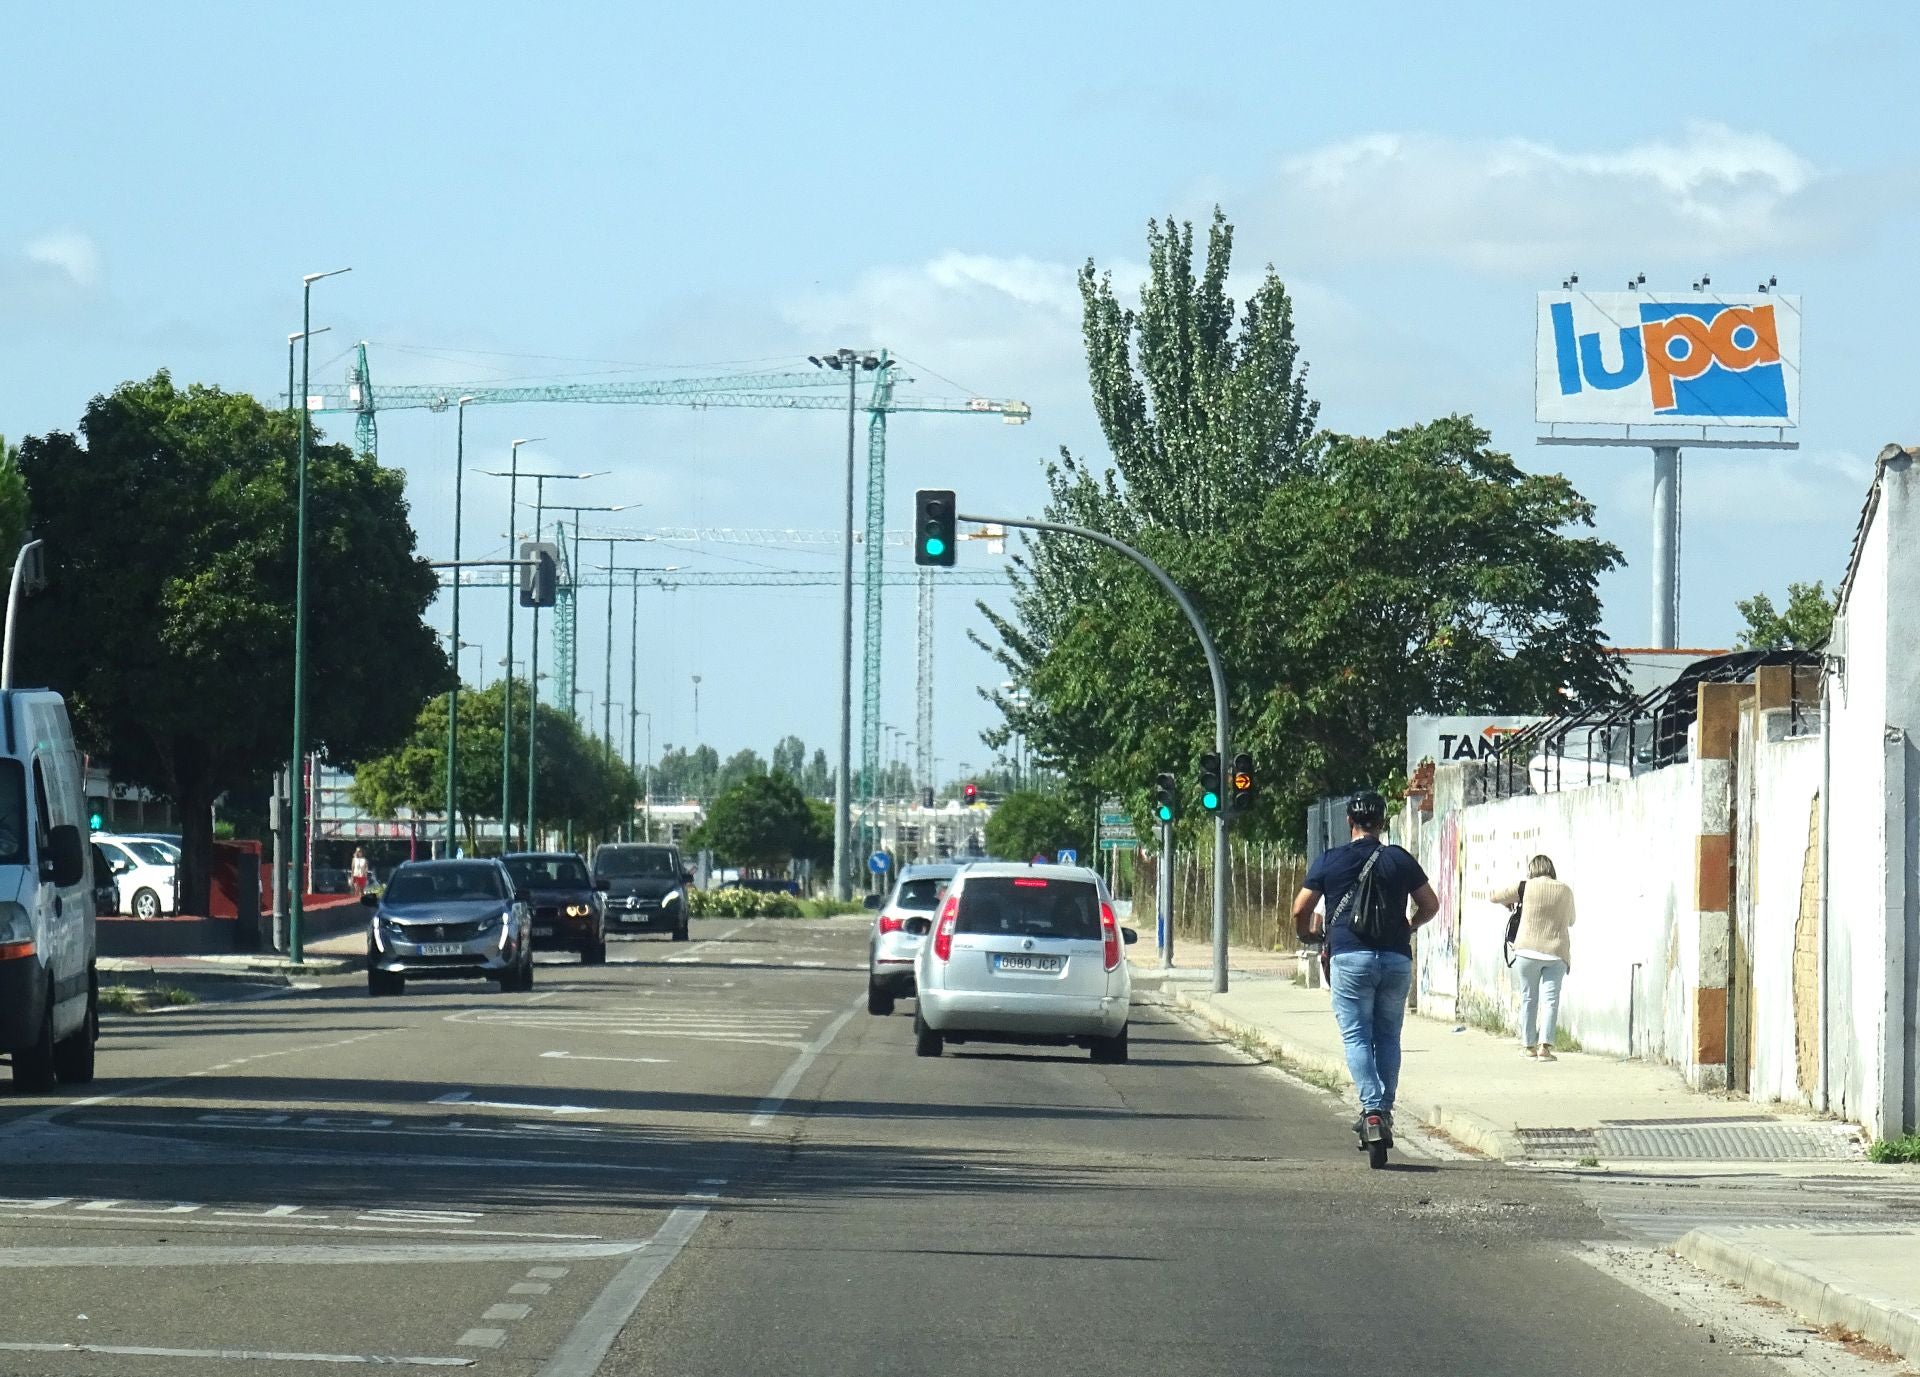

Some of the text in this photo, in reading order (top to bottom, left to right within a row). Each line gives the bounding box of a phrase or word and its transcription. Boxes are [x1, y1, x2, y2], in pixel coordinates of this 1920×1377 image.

[1550, 302, 1780, 410] lupa
[1002, 957, 1057, 970] 0080 JCP
